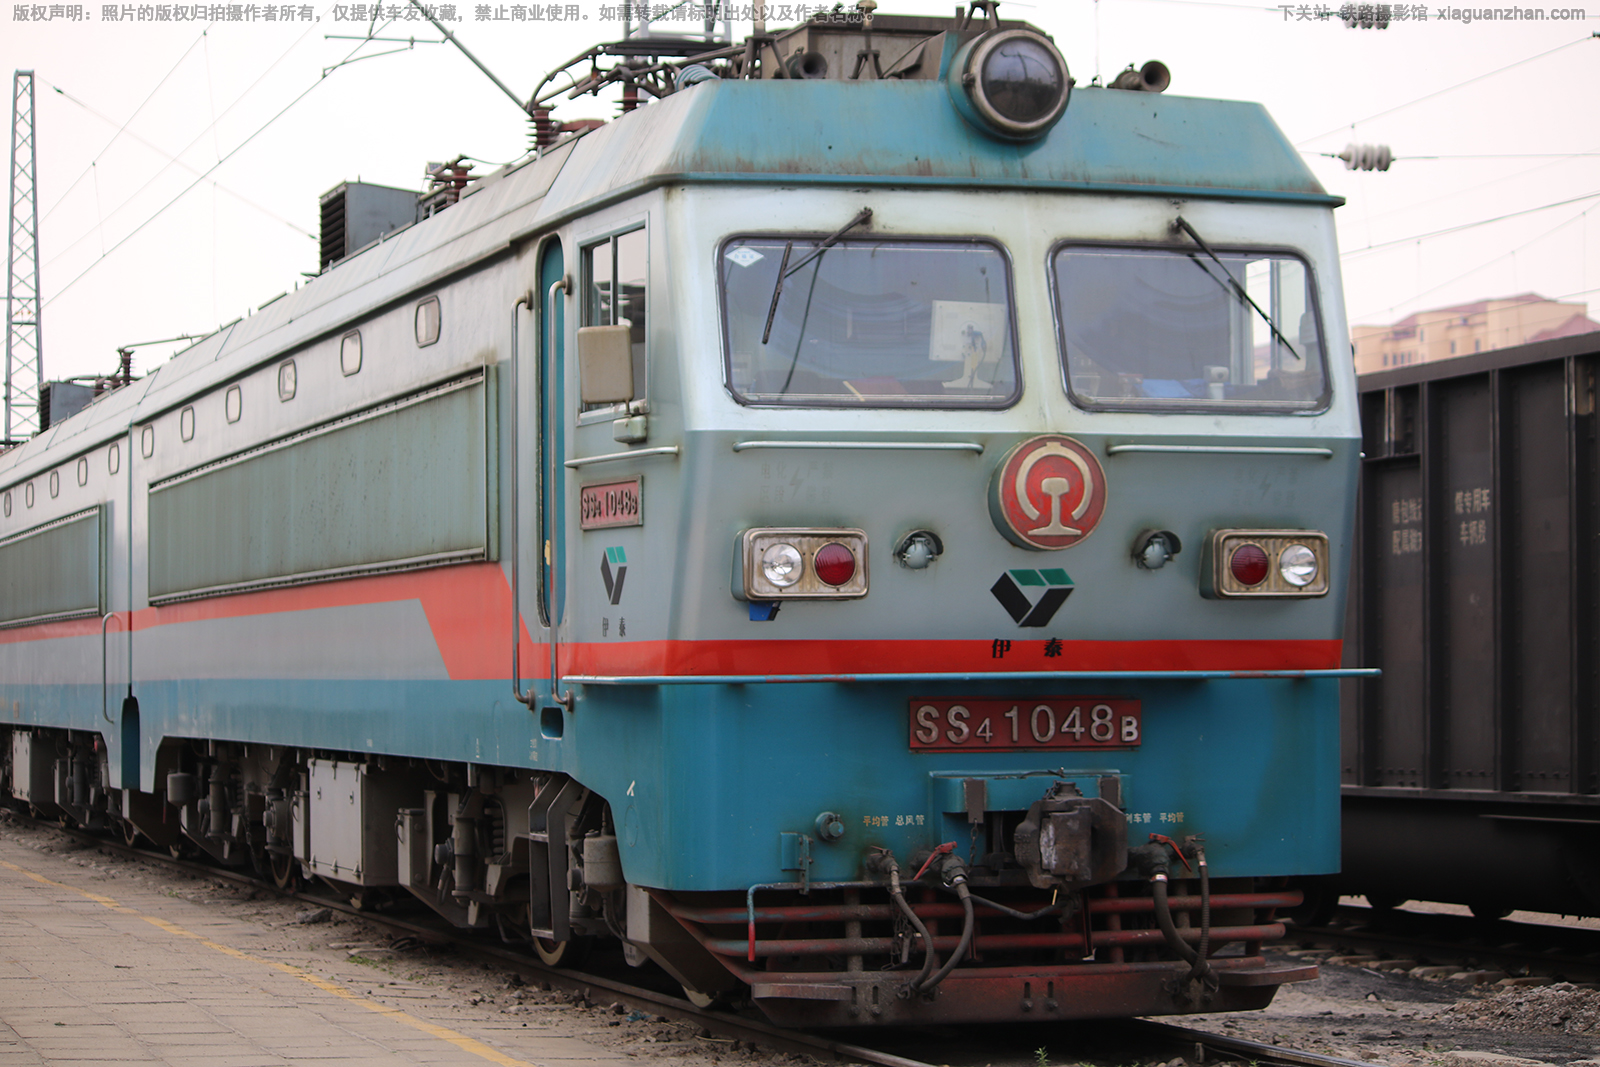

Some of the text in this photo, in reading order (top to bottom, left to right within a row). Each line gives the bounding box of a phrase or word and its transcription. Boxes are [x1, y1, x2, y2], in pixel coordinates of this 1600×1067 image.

[992, 637, 1063, 659] 伊泰
[863, 814, 925, 827] 平均管 总风管
[1159, 812, 1185, 823] 平均管
